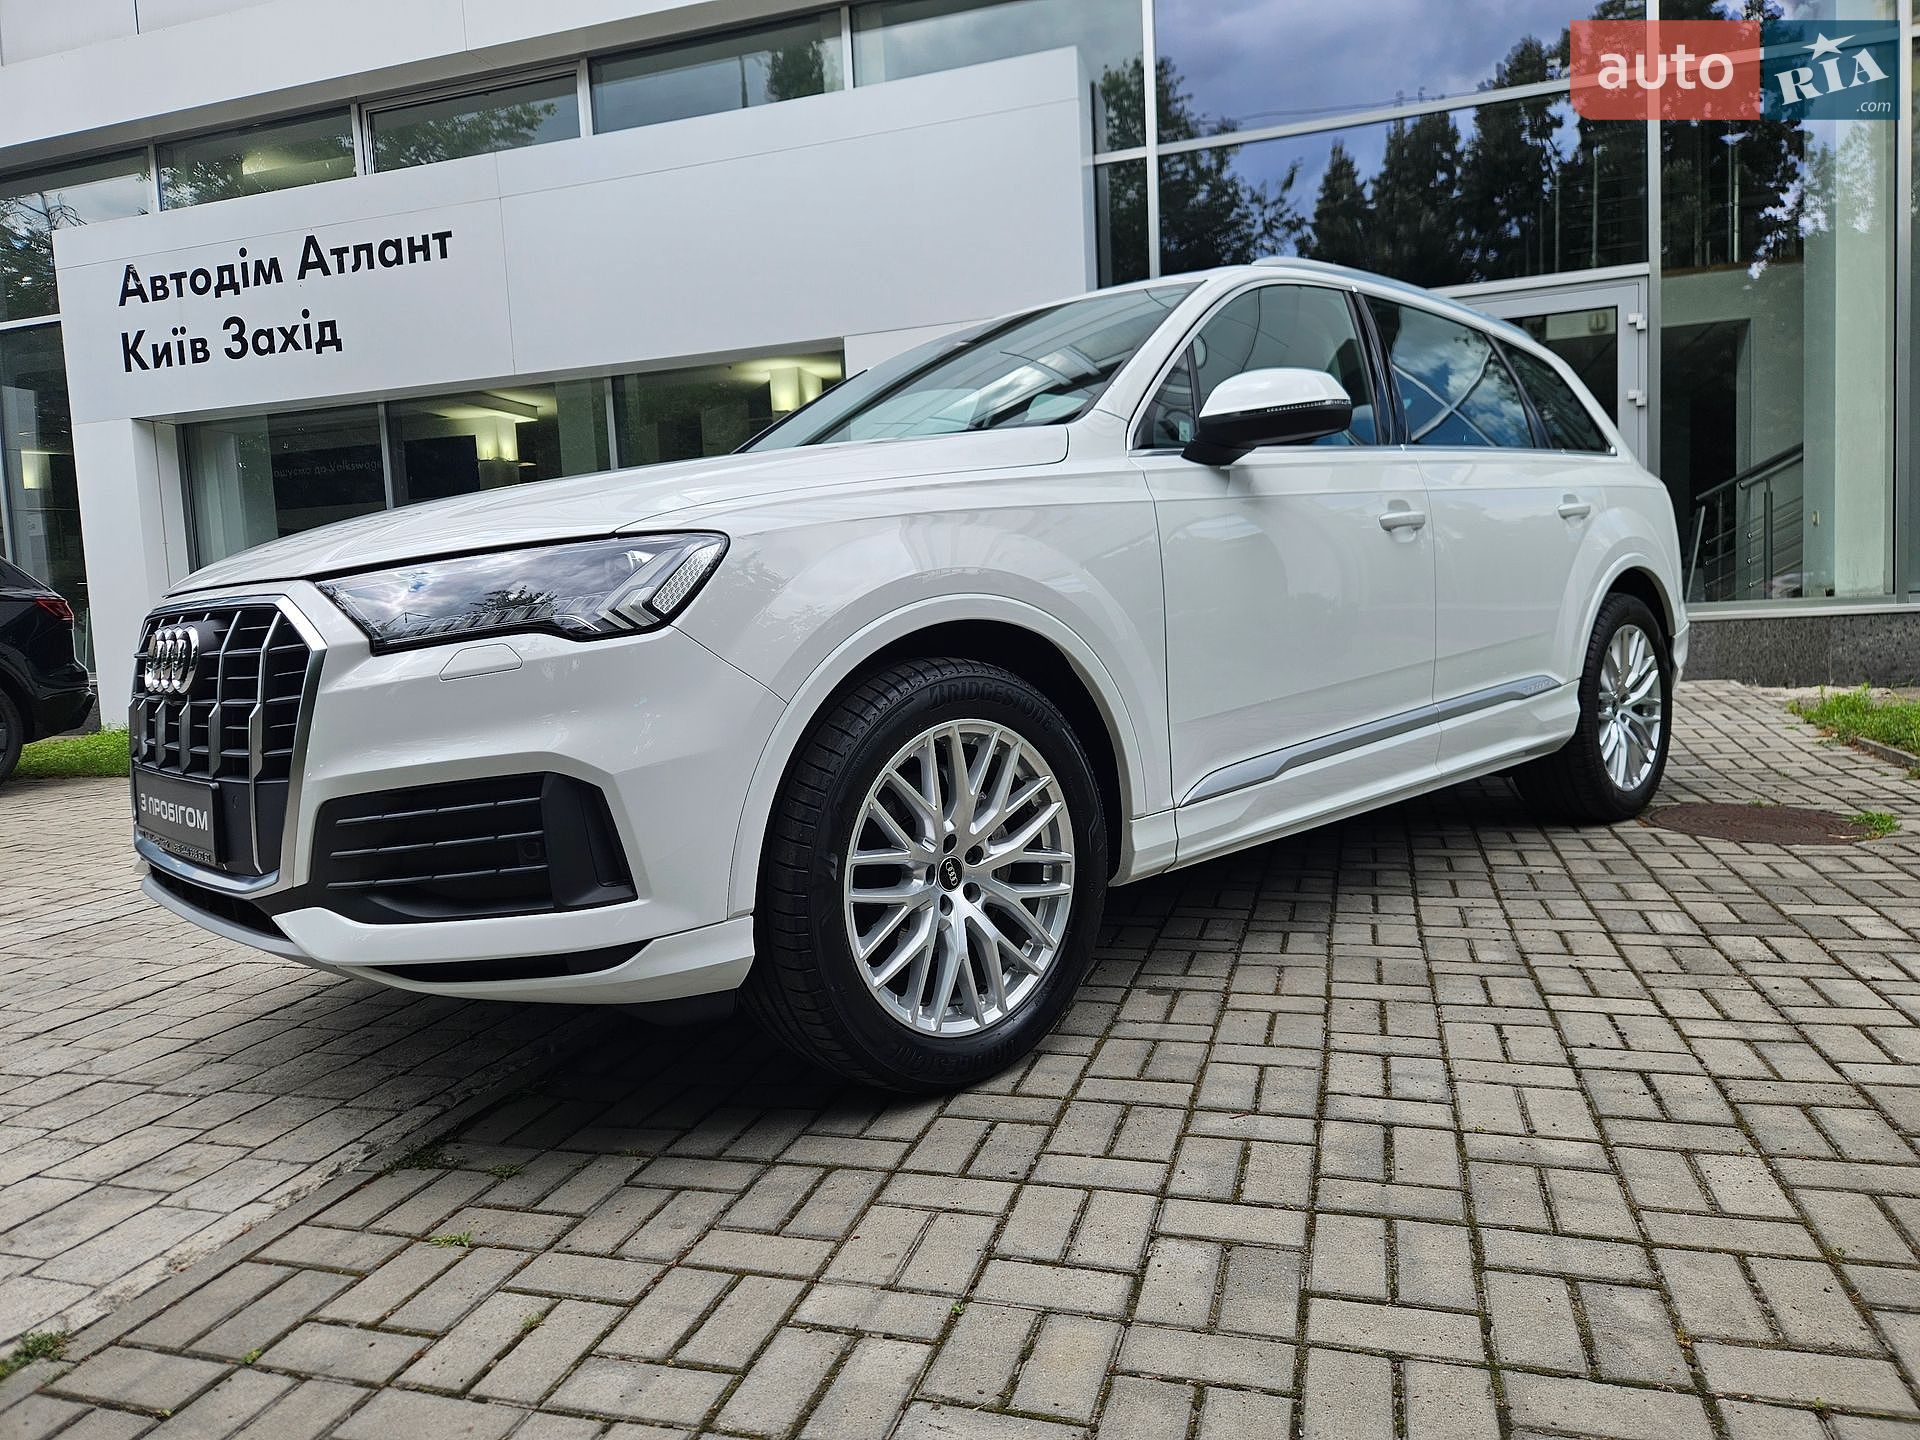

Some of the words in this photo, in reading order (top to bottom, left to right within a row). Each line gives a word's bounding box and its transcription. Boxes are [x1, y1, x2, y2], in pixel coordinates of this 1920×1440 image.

[119, 247, 283, 307] Автодім
[297, 230, 453, 280] Атлант
[120, 326, 211, 372] Київ
[222, 308, 343, 360] Захід
[140, 793, 147, 811] З
[148, 796, 208, 831] ПРОБІГОМ
